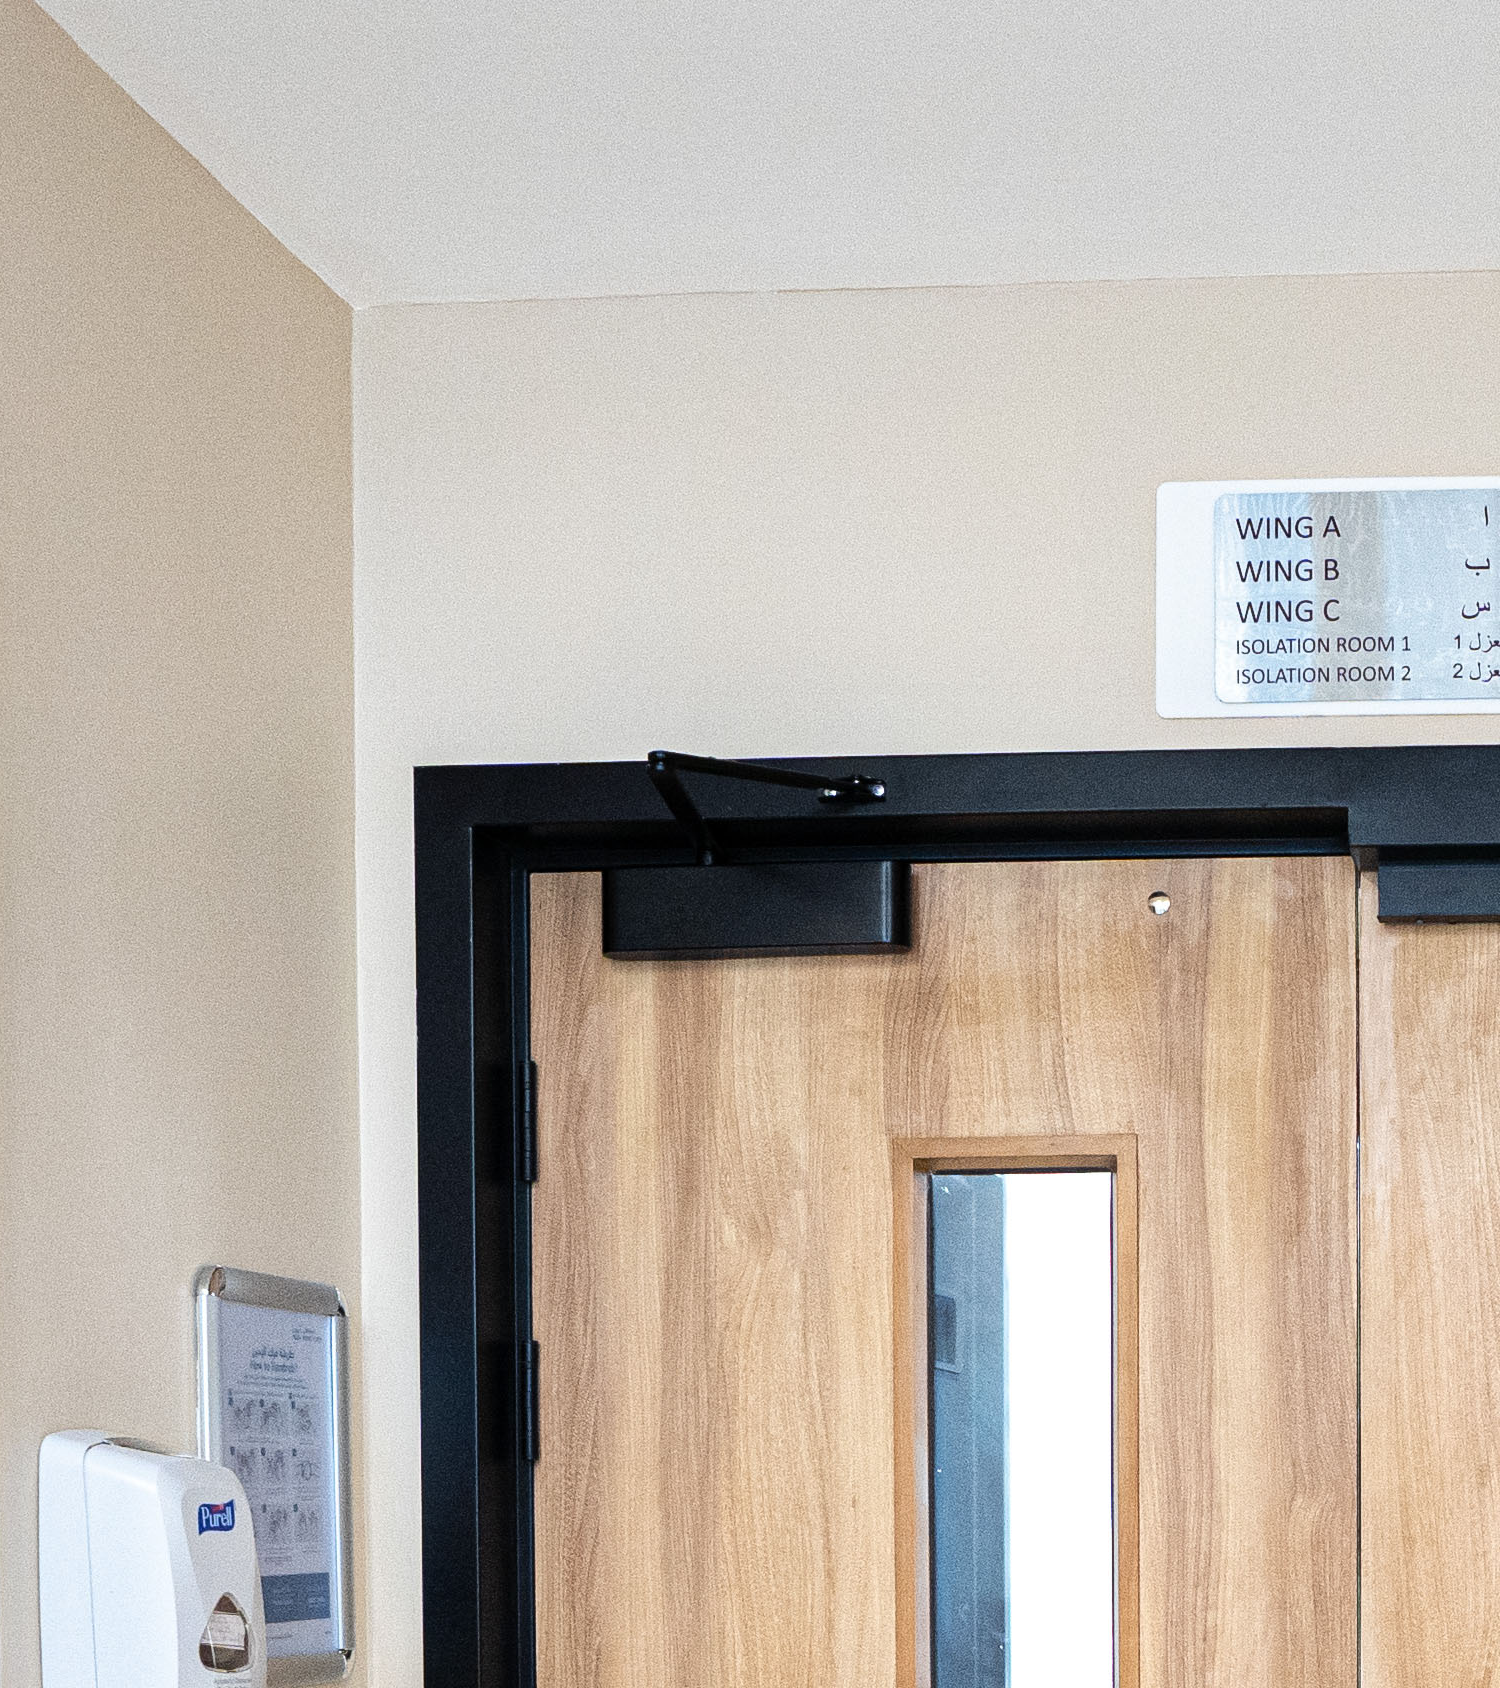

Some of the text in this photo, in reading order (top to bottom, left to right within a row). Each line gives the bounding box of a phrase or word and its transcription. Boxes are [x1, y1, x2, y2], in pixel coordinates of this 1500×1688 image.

[1236, 515, 1341, 540] WING A
[1236, 558, 1340, 582] WING B
[1464, 557, 1491, 577] ب
[1236, 599, 1340, 623] WING C
[1461, 600, 1491, 619] س
[1236, 636, 1411, 655] ISOLATION ROOM 1
[1454, 634, 1461, 650] 1
[1236, 665, 1411, 684] ISOLATION ROOM 2
[1452, 663, 1464, 679] 2
[201, 1506, 233, 1529] Purell
